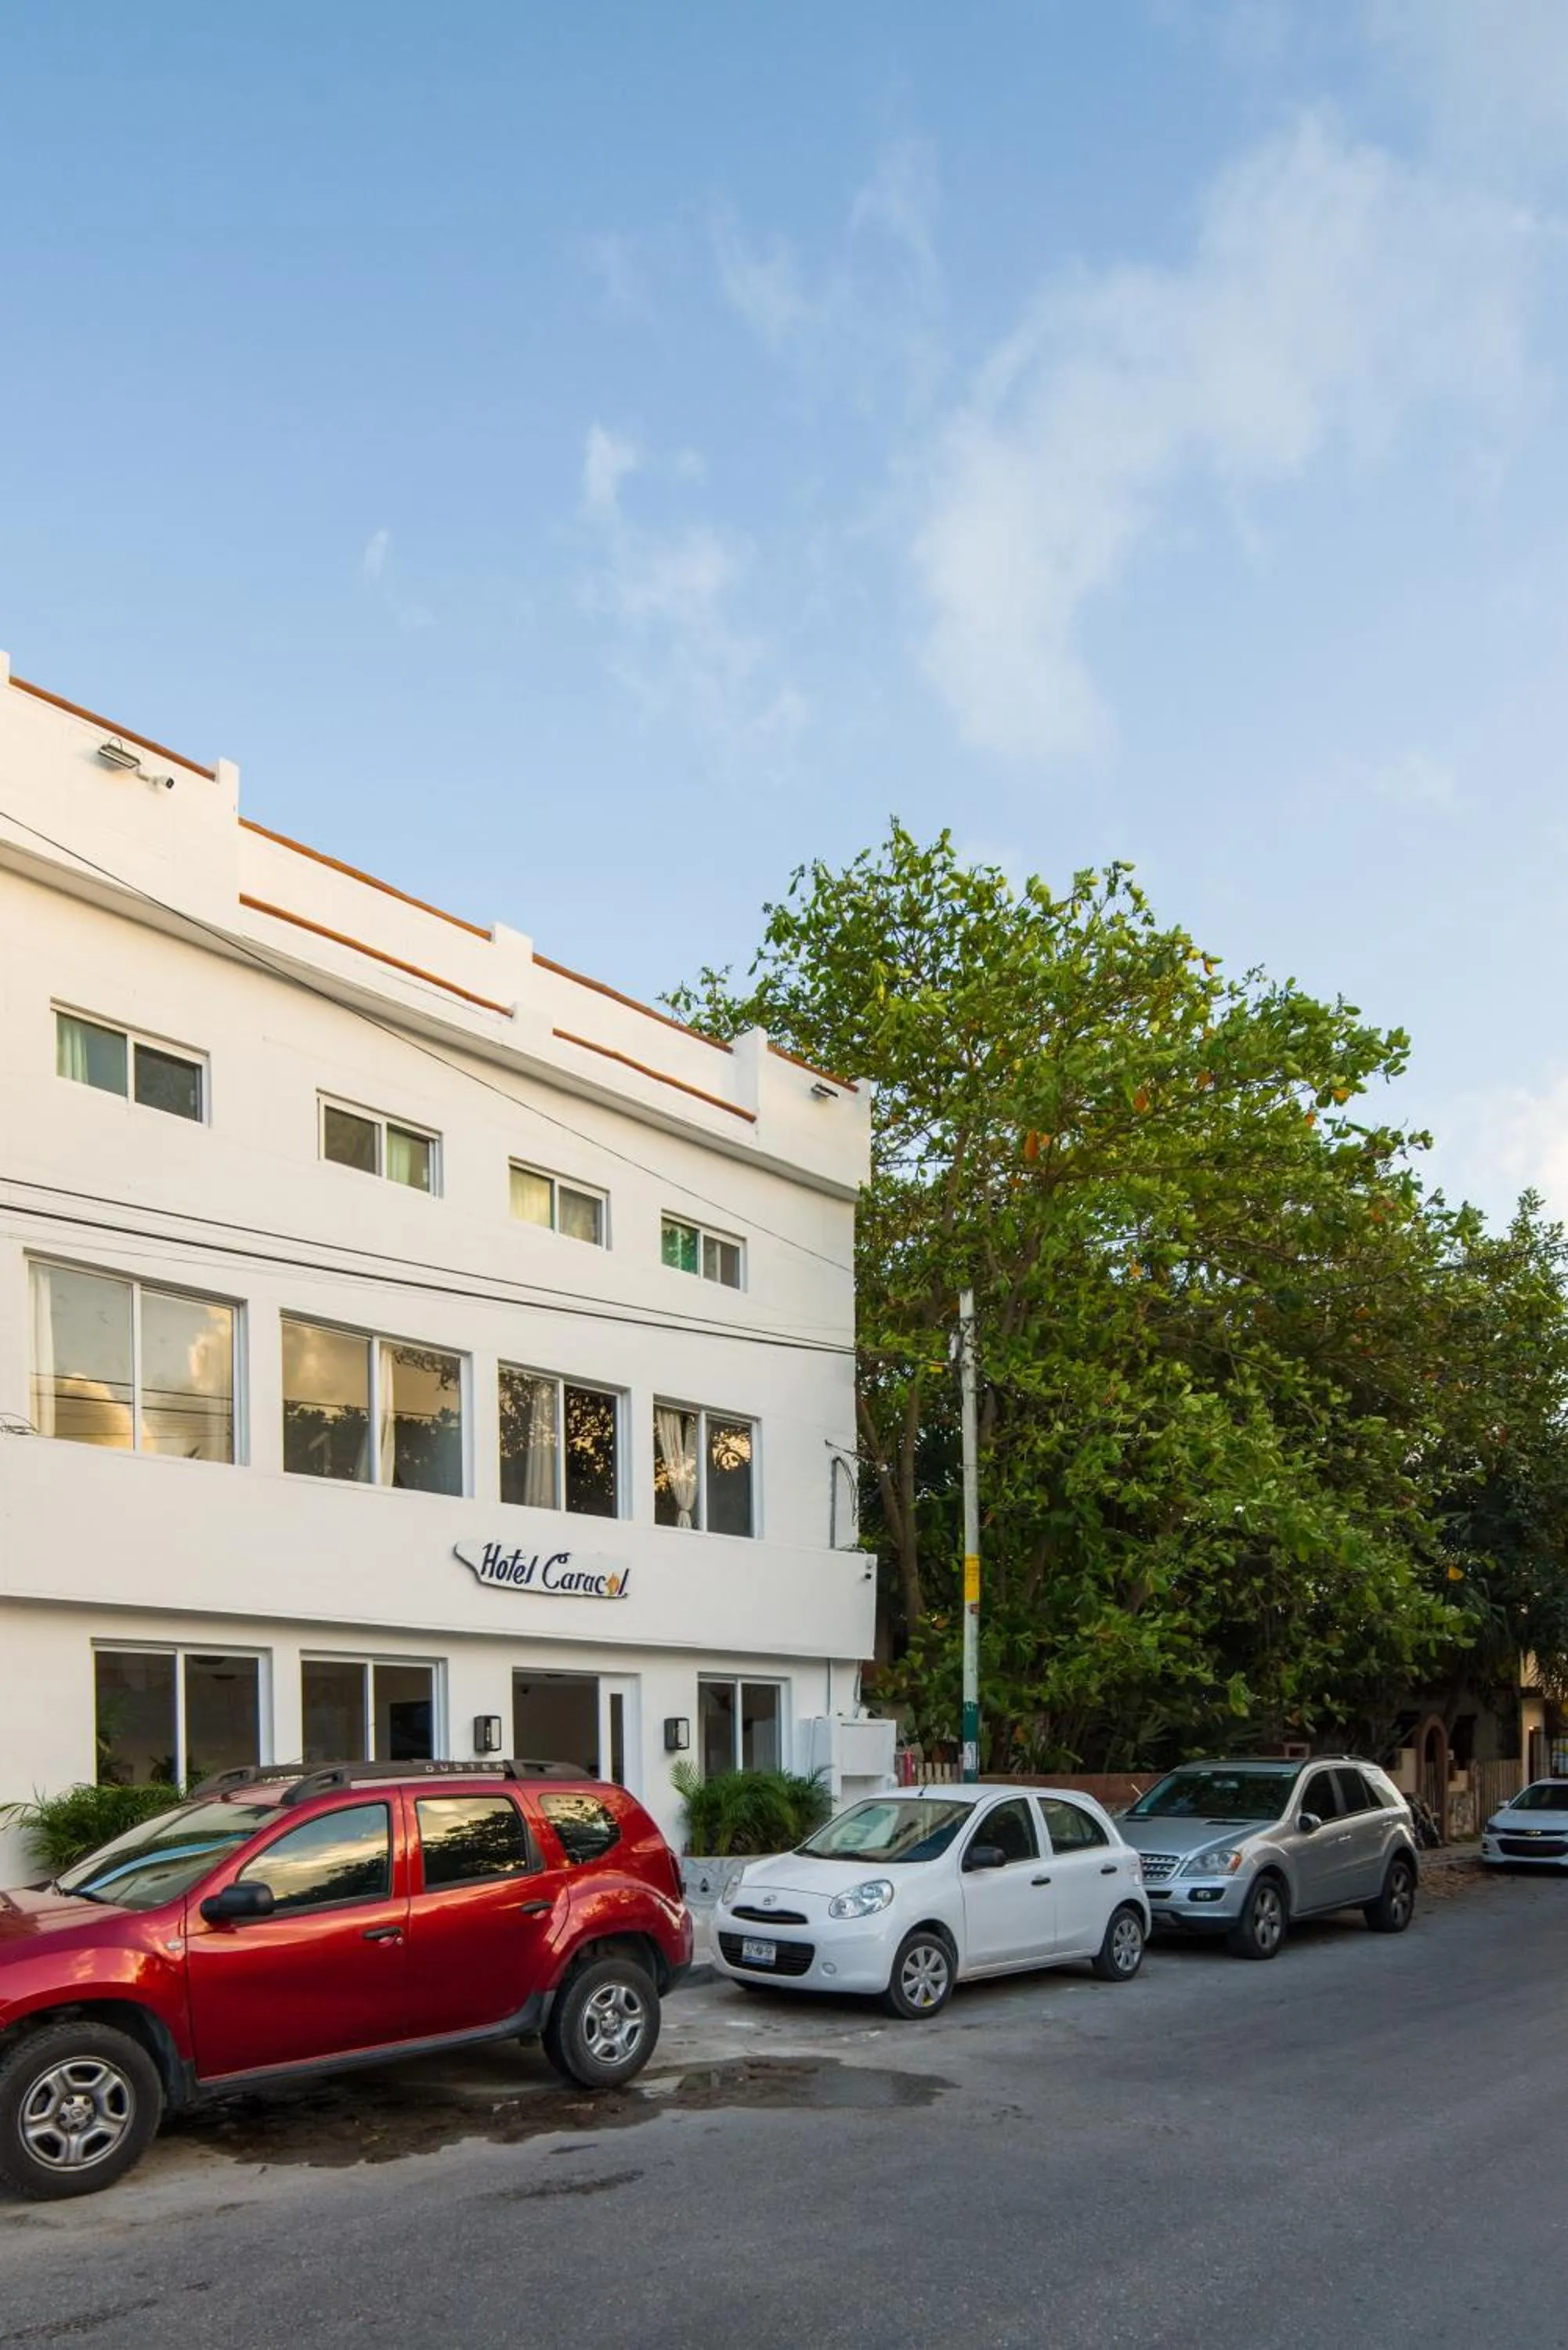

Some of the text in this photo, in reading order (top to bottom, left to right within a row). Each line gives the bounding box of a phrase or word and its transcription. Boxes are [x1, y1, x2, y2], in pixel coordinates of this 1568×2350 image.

[481, 1542, 630, 1595] Hotel Caracol
[425, 1763, 504, 1773] DUSTER
